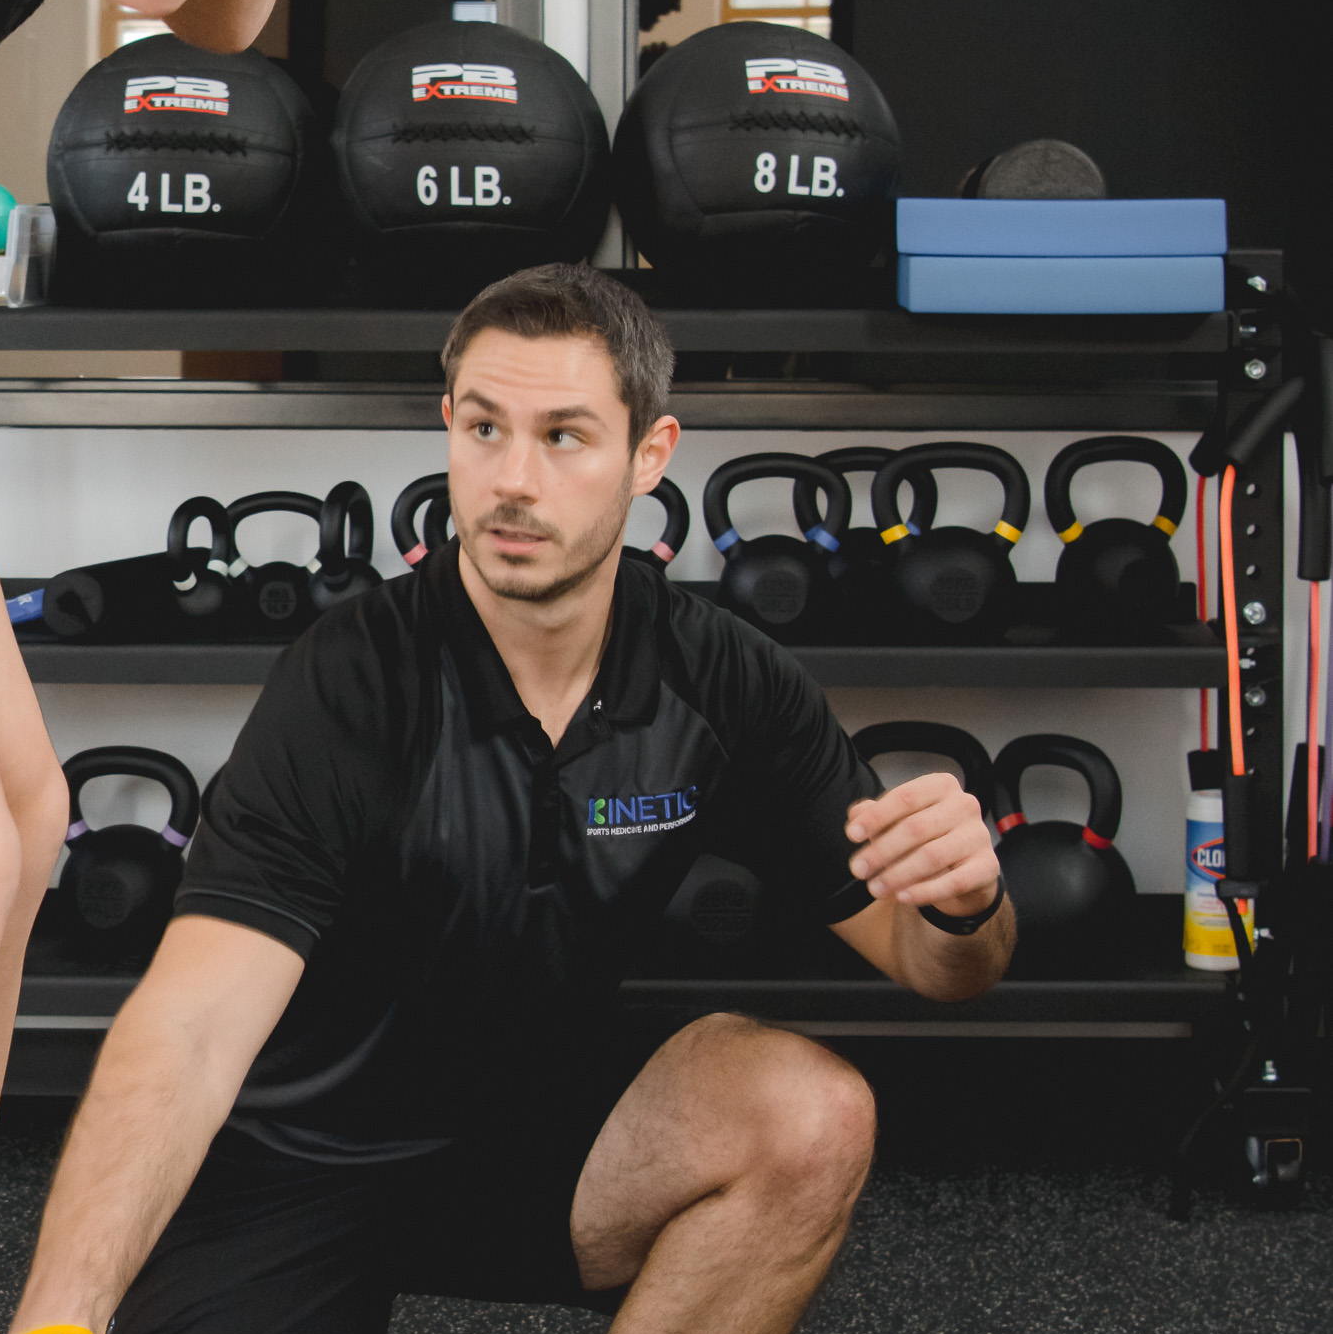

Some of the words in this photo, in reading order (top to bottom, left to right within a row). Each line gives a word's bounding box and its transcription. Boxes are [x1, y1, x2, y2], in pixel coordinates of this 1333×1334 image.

[412, 64, 517, 86] PB
[745, 58, 847, 85] PB
[125, 75, 230, 98] PB
[412, 83, 518, 102] EXTREME
[747, 76, 849, 101] EXTREME
[124, 93, 229, 114] EXTREME
[417, 165, 438, 206] 6
[450, 166, 512, 206] LB.
[754, 152, 777, 193] 8
[788, 154, 845, 198] LB.
[127, 171, 149, 212] 4
[160, 173, 222, 213] LB.
[586, 828, 610, 836] SPORTS
[643, 823, 659, 833] AND
[1197, 848, 1225, 868] CLO
